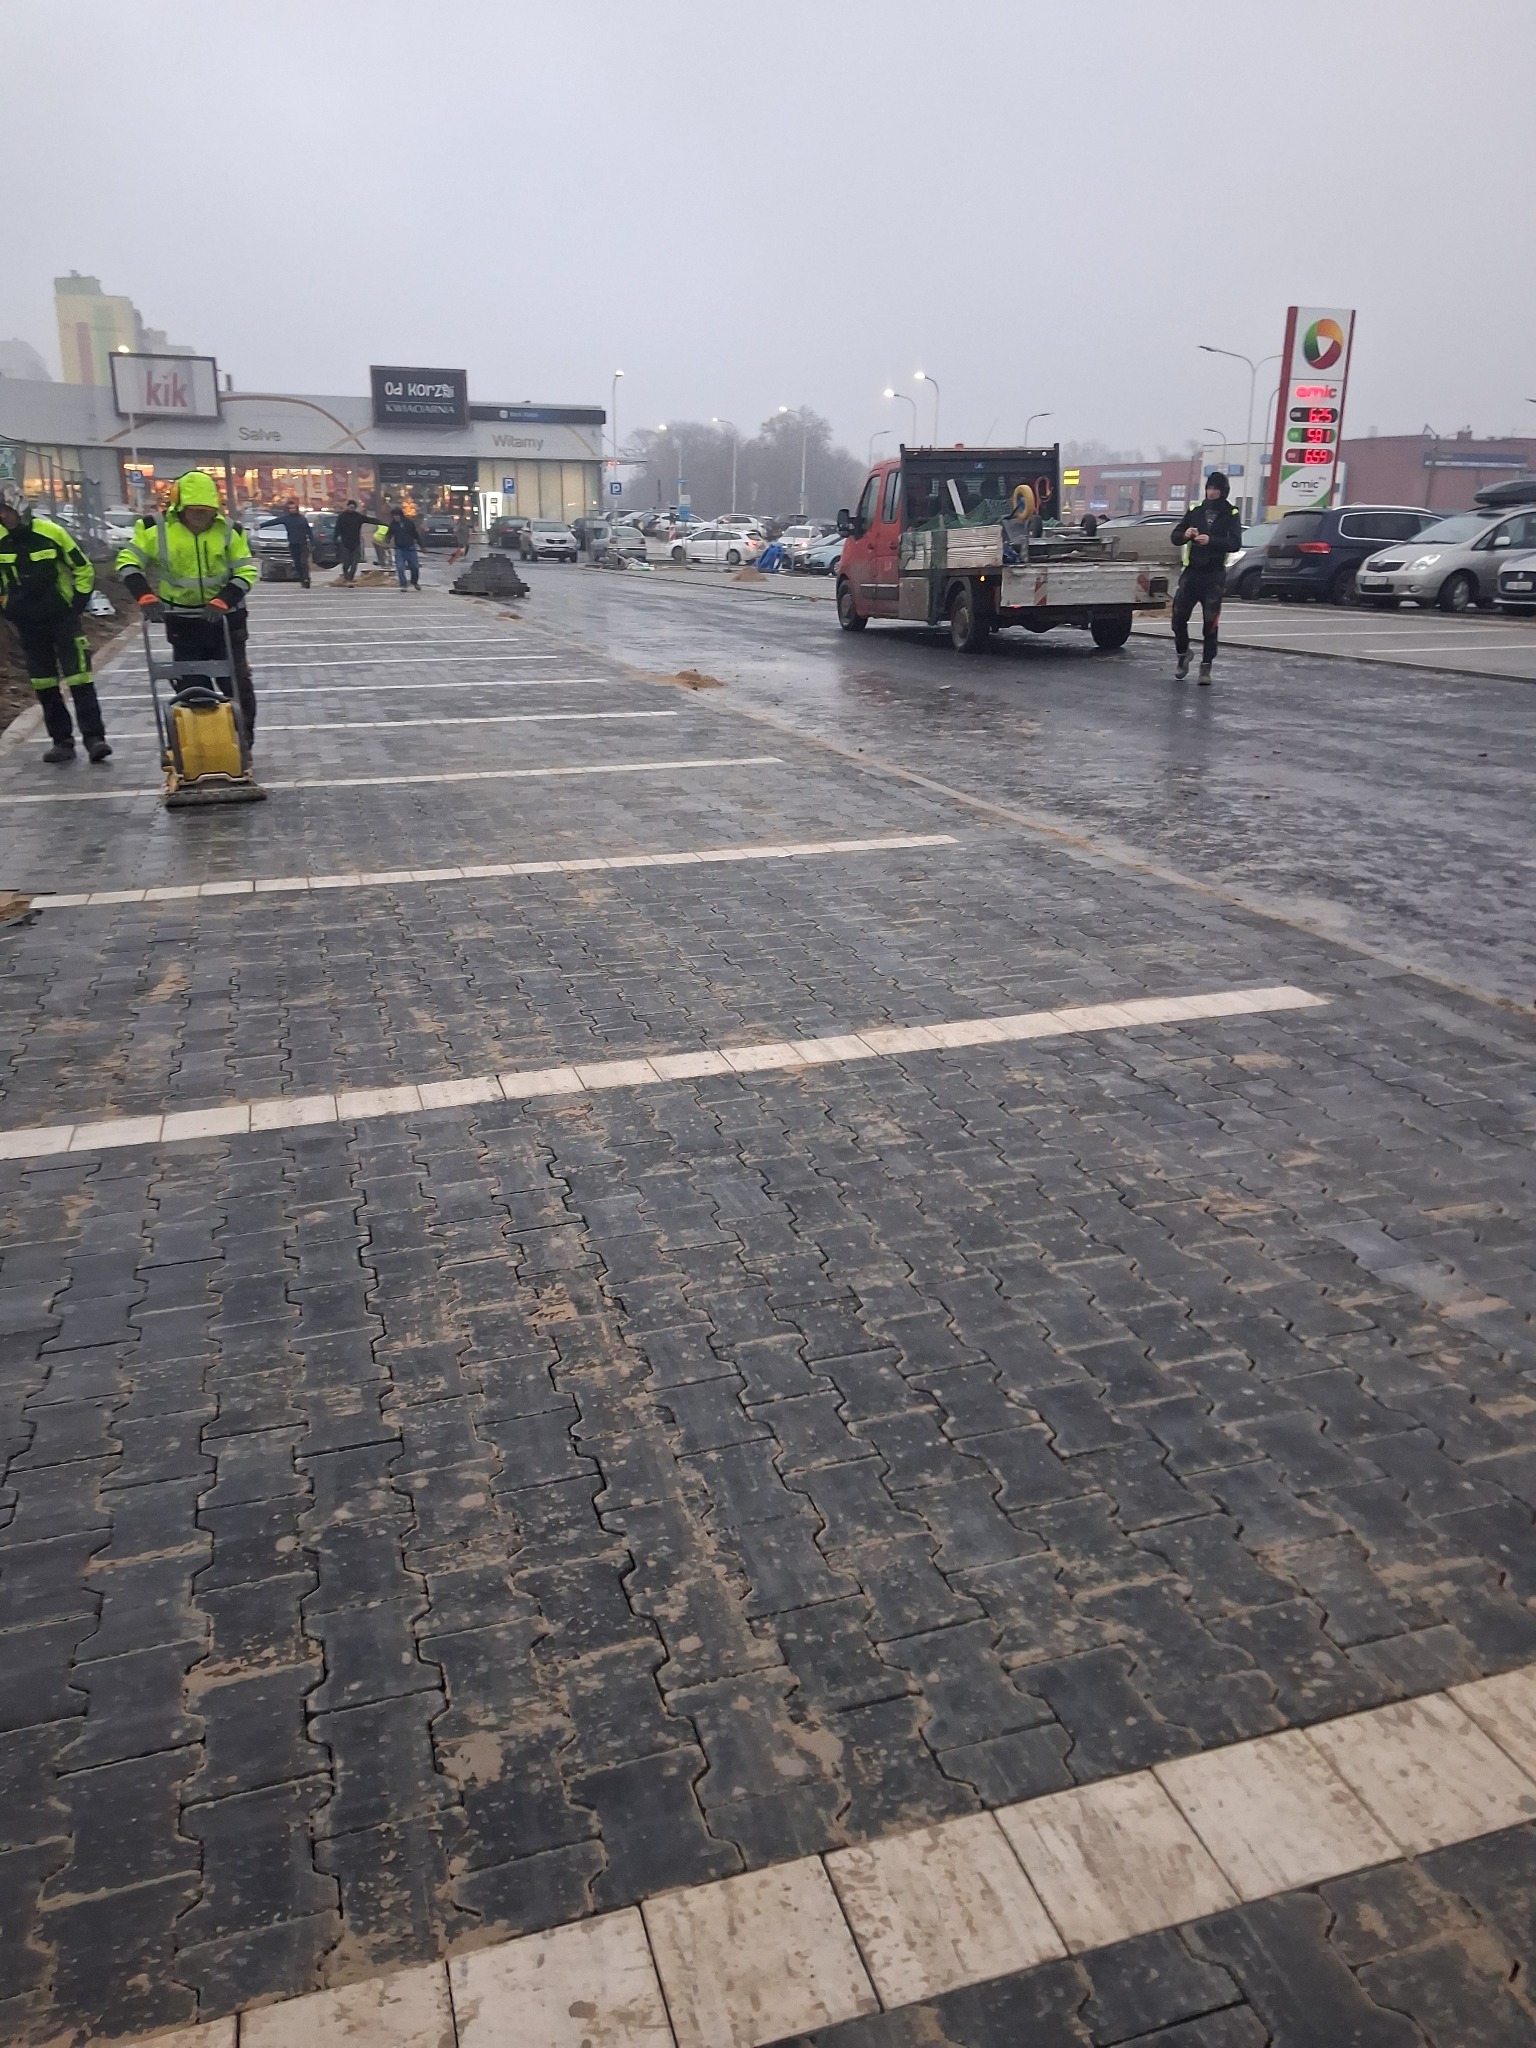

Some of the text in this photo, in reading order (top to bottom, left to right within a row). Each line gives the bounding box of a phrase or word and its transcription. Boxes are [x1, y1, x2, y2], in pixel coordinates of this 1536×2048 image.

[1295, 385, 1337, 398] amic
[238, 427, 281, 442] Salve
[492, 434, 544, 451] Witamy
[1291, 479, 1320, 488] amic
